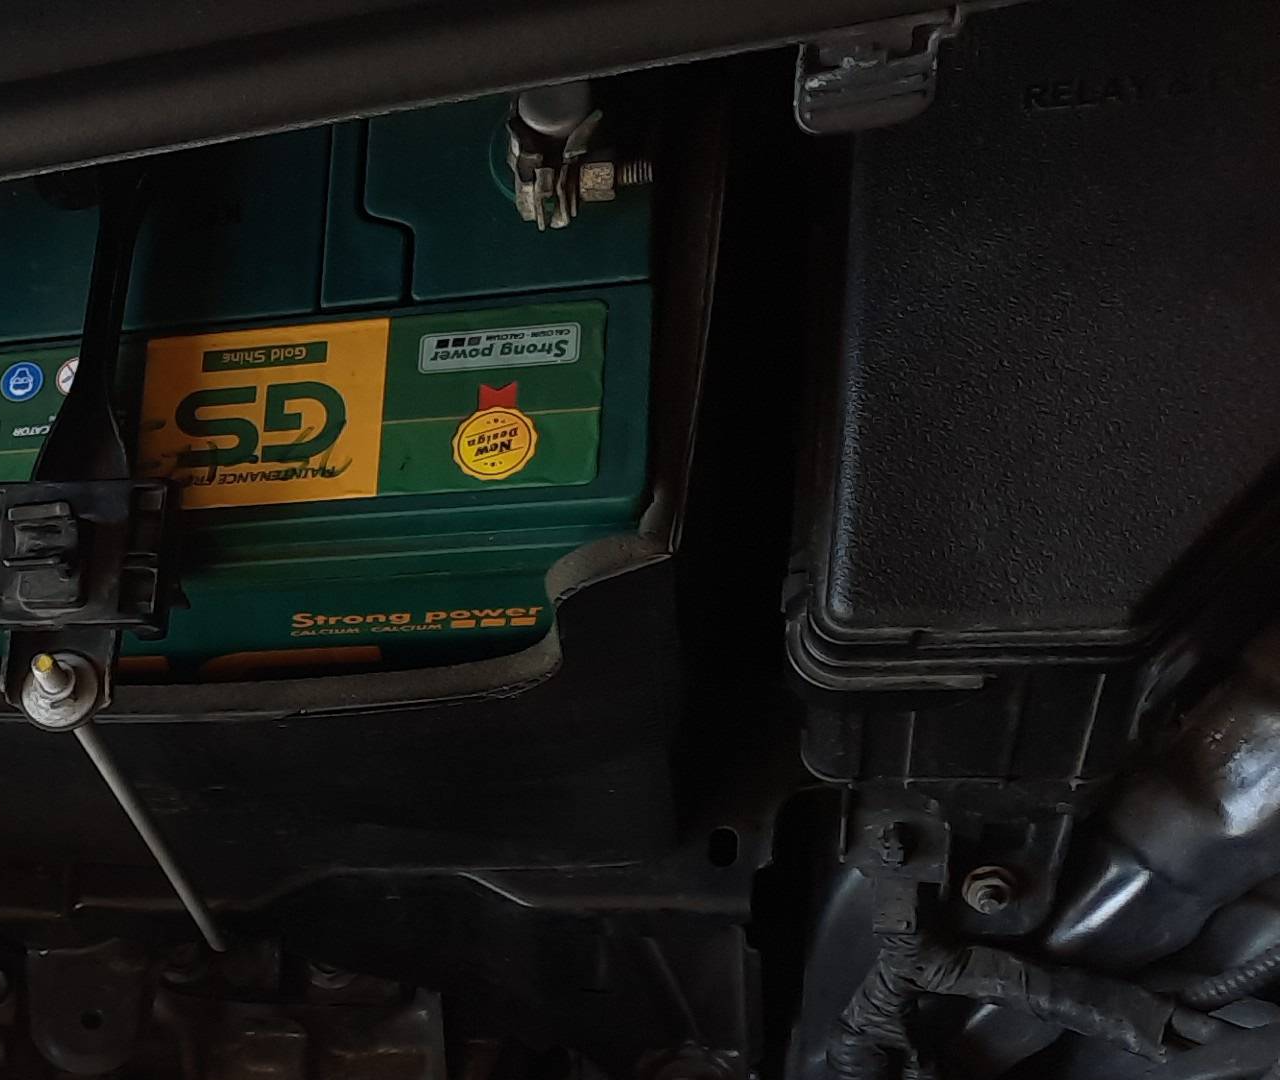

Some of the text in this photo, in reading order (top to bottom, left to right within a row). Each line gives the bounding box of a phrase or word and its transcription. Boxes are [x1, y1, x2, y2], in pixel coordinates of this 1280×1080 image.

[486, 331, 525, 342] CALCIUM
[530, 328, 571, 339] CALCIUM
[222, 346, 307, 364] Gold Shine
[430, 339, 569, 363] Strong power
[175, 381, 347, 469] GS
[468, 425, 520, 448] Design
[474, 438, 513, 458] New
[218, 466, 338, 485] MAINTENANCE
[290, 606, 544, 629] Strong power
[290, 623, 442, 638] CALCIUM CALCIUM
